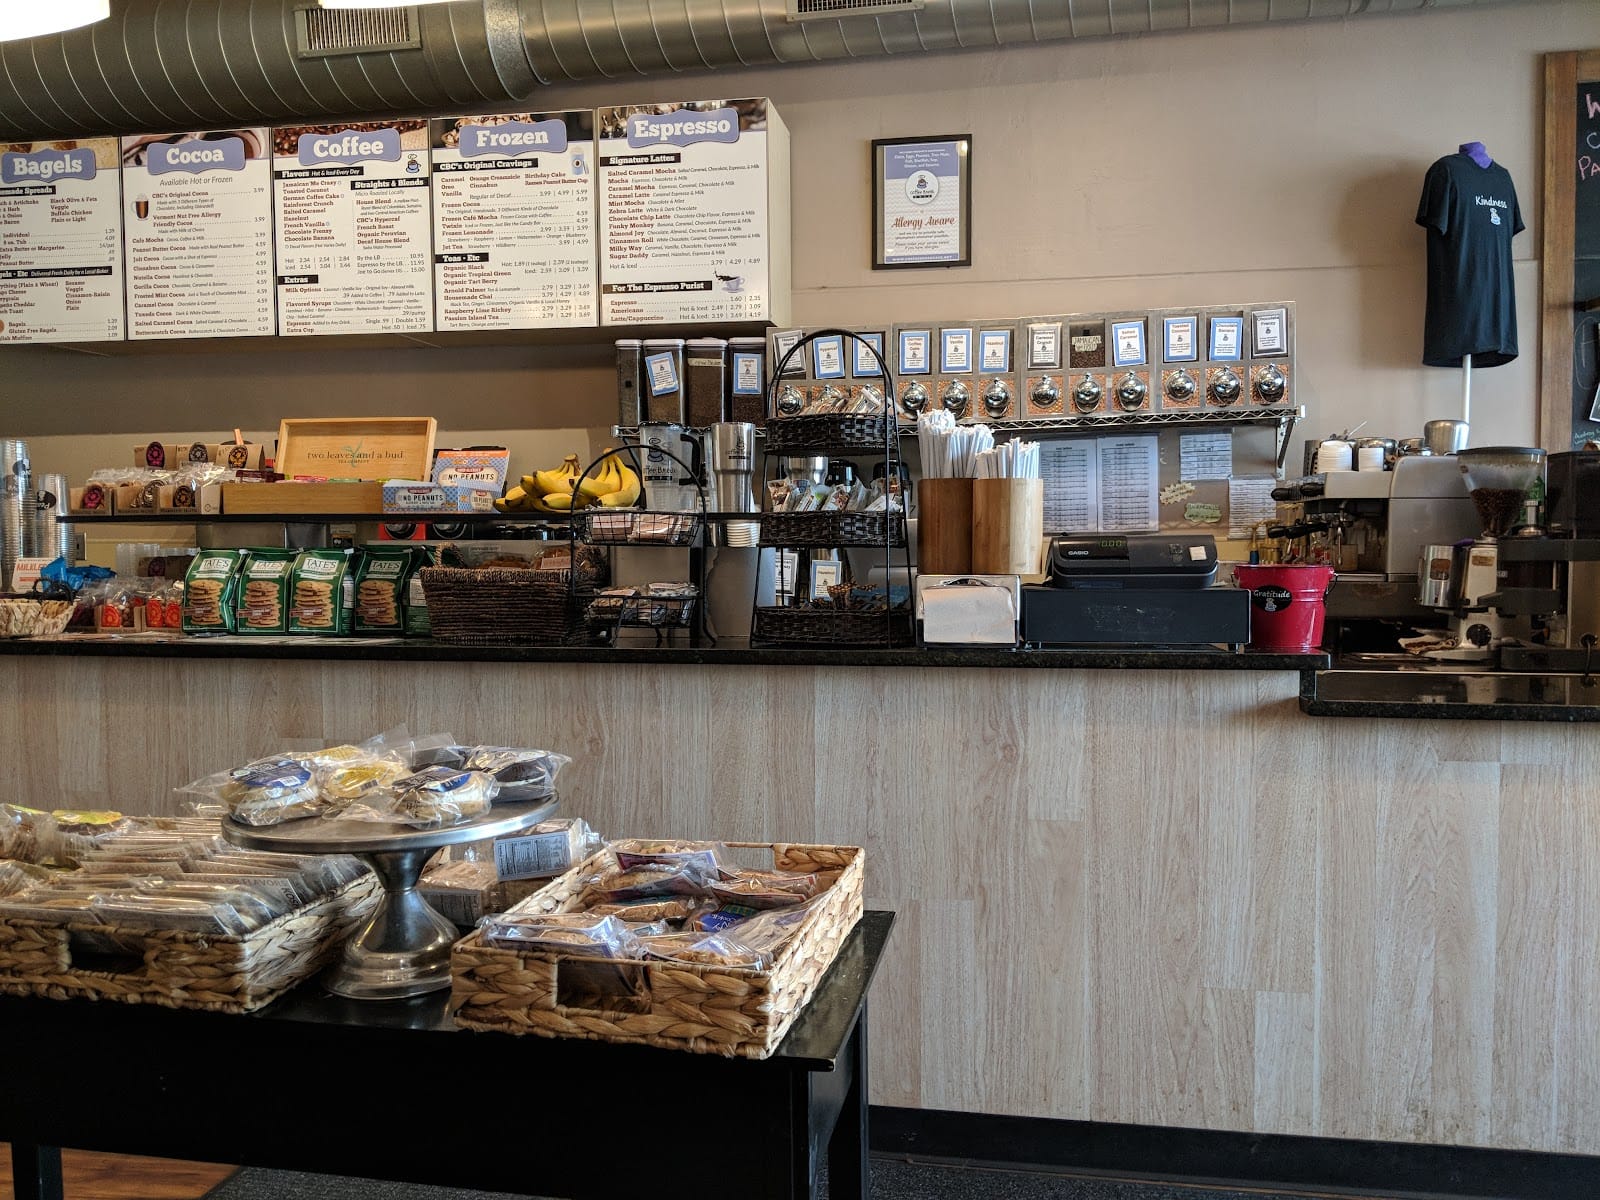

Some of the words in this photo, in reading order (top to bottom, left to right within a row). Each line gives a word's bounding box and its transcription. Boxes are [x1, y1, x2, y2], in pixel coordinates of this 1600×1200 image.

[635, 119, 731, 141] Espresso
[477, 130, 548, 147] Frozen
[313, 136, 384, 157] Coffee
[167, 148, 224, 164] Cocoa
[610, 157, 648, 166] Signature
[13, 154, 82, 178] Bagels
[464, 161, 496, 170] Original
[497, 160, 532, 169] Cravings
[160, 178, 188, 186] Available
[1476, 195, 1507, 208] Kindness
[891, 216, 922, 230] Allergy
[925, 216, 956, 226] Aware
[627, 283, 642, 291] The
[644, 283, 679, 292] Espresso
[681, 281, 704, 289] Purist
[1254, 590, 1290, 598] Gratitude
